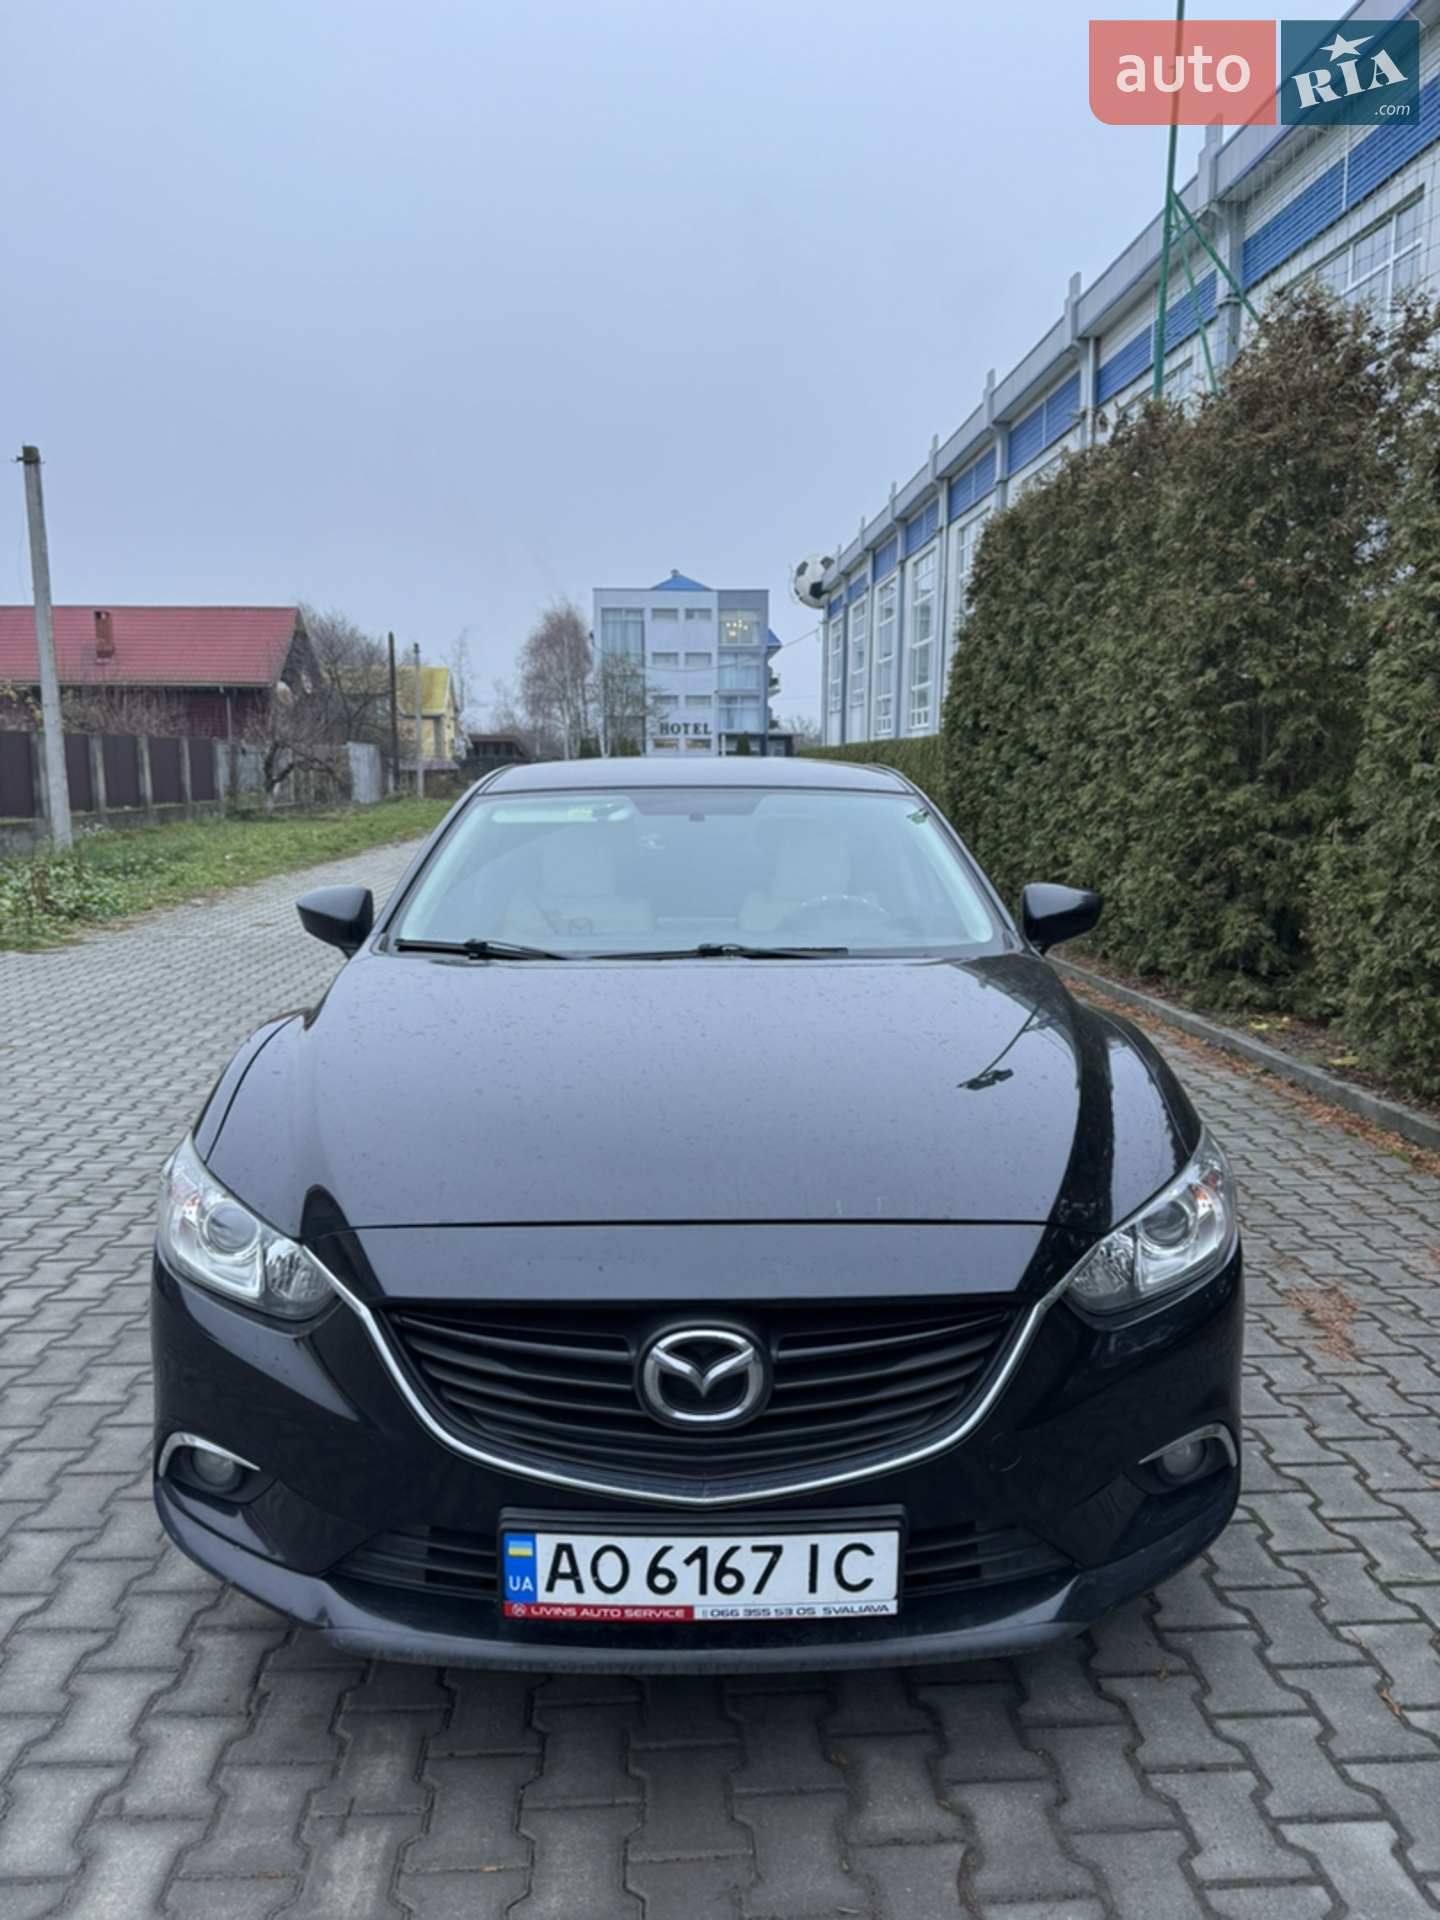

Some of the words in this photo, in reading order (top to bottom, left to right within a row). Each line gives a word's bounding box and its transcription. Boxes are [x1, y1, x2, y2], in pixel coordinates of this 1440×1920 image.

[659, 722, 712, 735] HOTEL
[545, 1543, 630, 1594] AO
[646, 1544, 794, 1596] 6167
[808, 1542, 875, 1594] IC
[508, 1575, 534, 1592] UA
[580, 1607, 622, 1618] AUTO
[624, 1608, 685, 1619] SERVICE
[710, 1608, 739, 1617] 066
[823, 1604, 889, 1615] SVALIAVA
